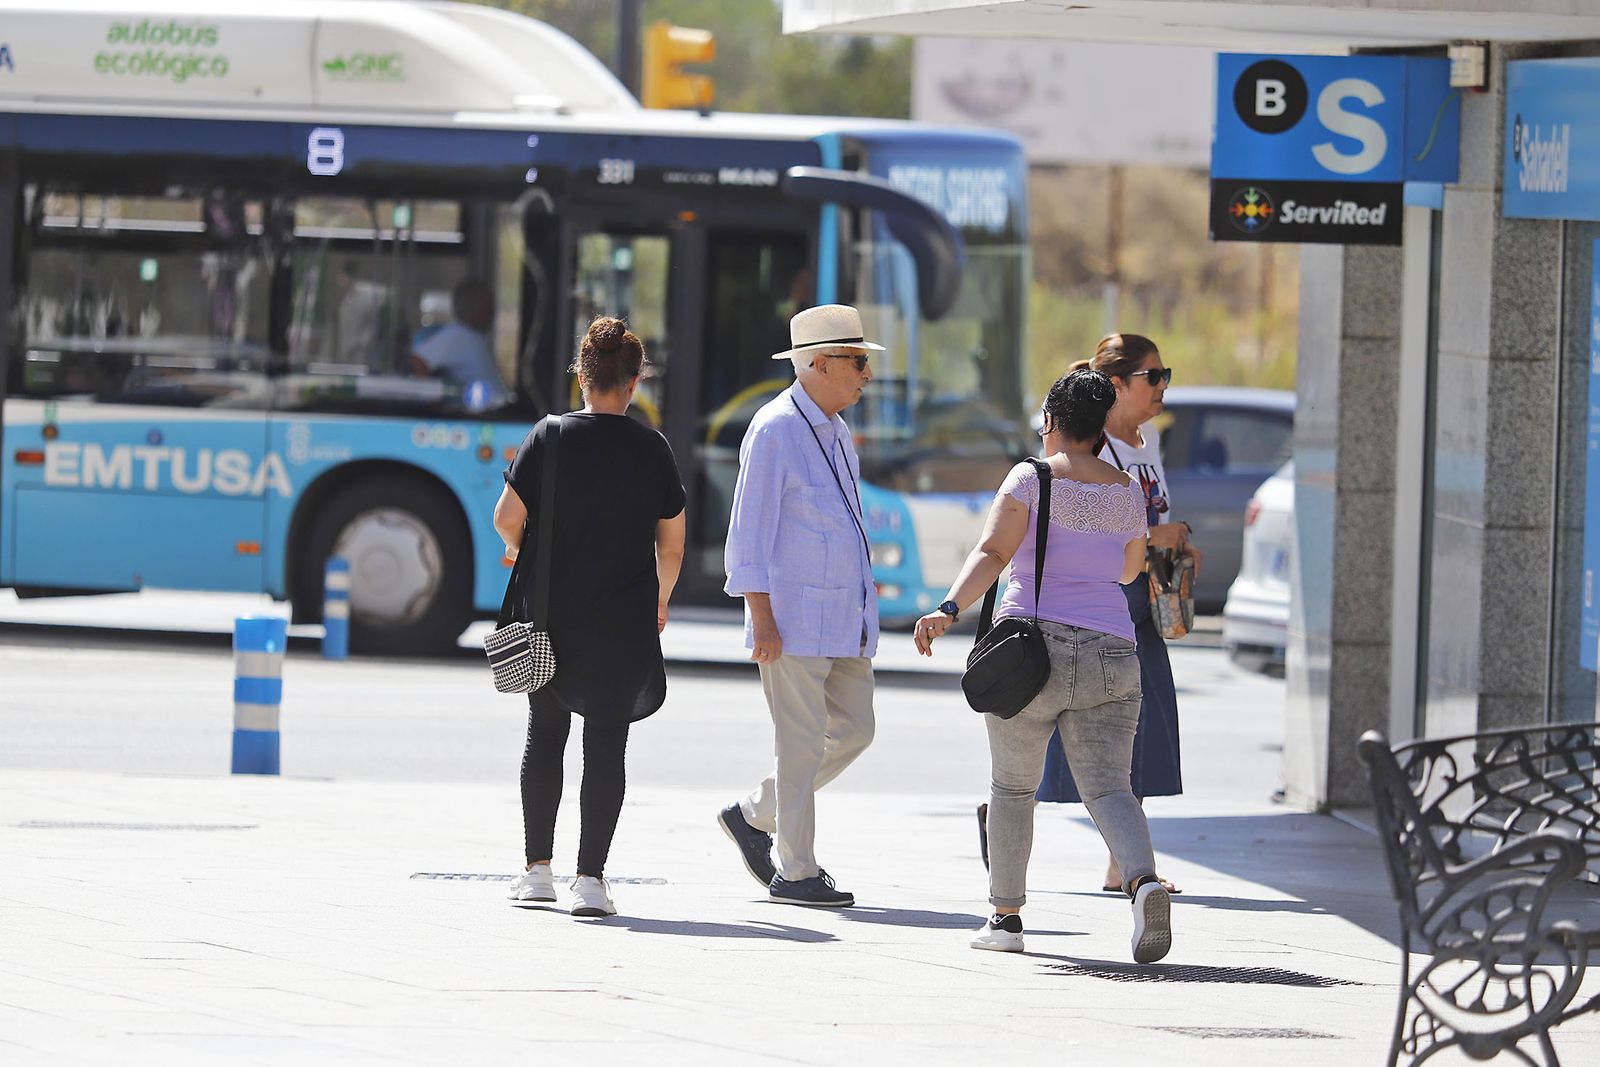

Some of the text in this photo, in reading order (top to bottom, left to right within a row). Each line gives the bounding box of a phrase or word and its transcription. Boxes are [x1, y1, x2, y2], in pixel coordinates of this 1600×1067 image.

[307, 127, 345, 176] 8
[1255, 78, 1388, 175] B S
[1519, 124, 1569, 193] Sabadell
[1279, 199, 1388, 226] ServiRed
[44, 443, 293, 498] EMTUSA
